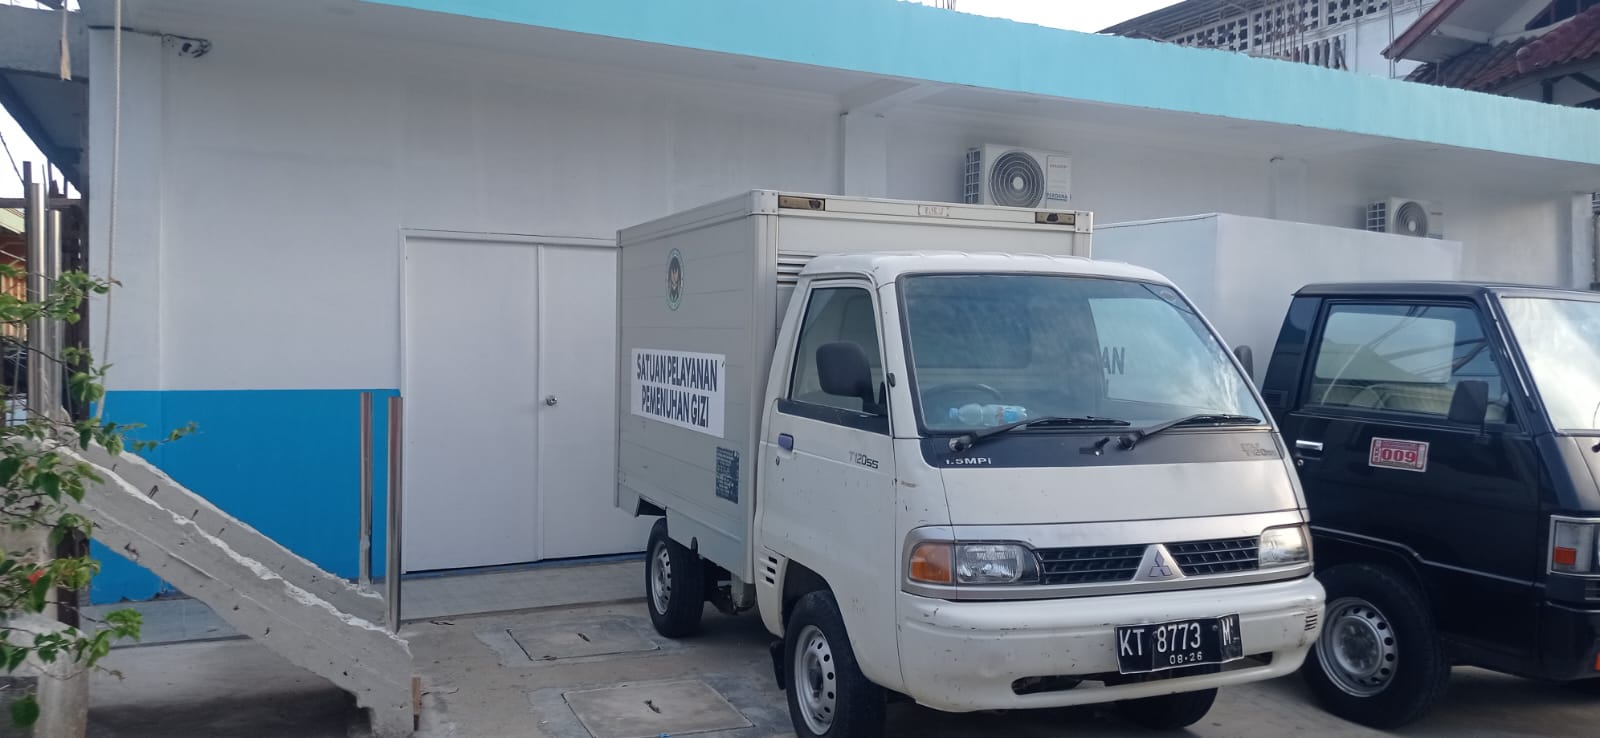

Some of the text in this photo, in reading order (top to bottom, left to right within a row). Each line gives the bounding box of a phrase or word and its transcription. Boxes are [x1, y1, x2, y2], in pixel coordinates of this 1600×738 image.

[637, 353, 717, 392] SATUAN PELAYANAN
[642, 384, 709, 428] PEMENUHAN GIZI
[1382, 449, 1417, 463] 009
[1119, 629, 1145, 657] KT
[1157, 622, 1201, 653] 8773
